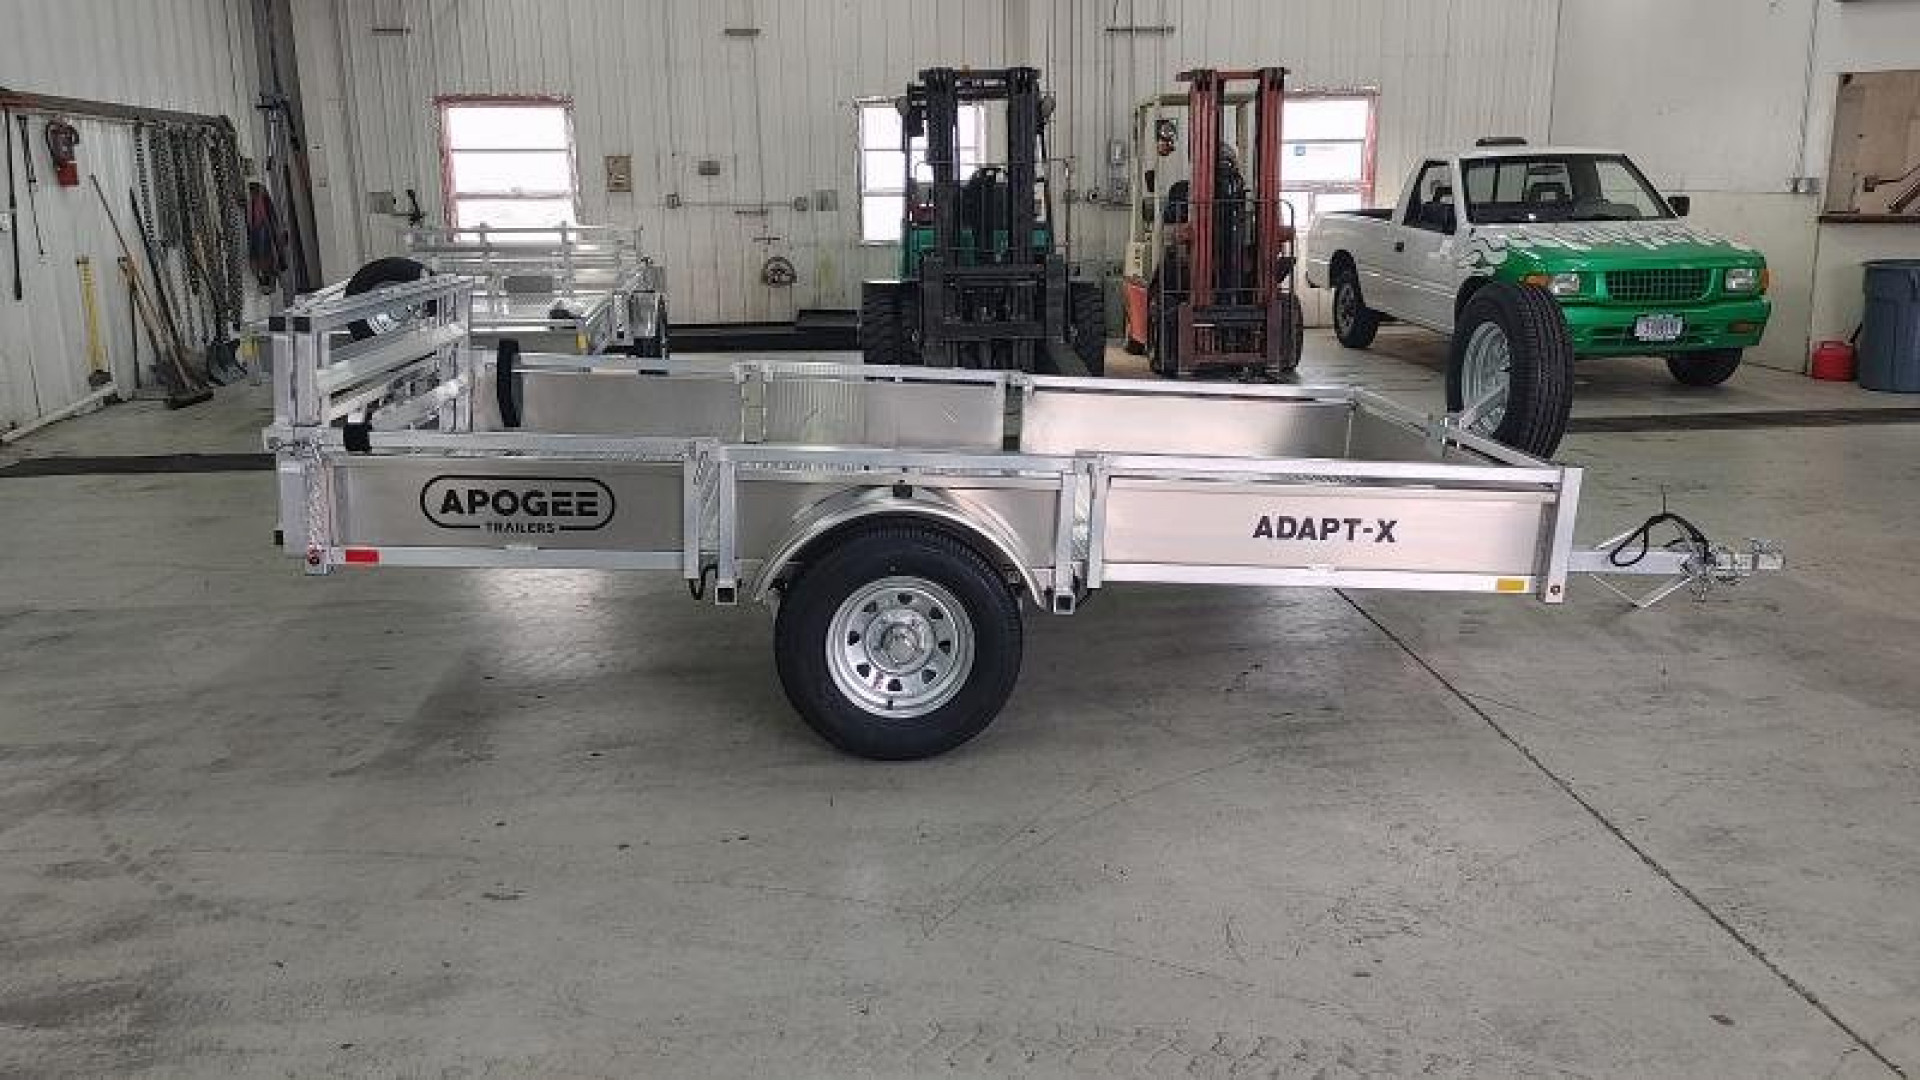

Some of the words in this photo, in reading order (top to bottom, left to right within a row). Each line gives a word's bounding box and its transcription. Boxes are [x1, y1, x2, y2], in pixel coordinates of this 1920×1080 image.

[440, 489, 598, 517] APOGEE
[485, 522, 556, 534] TRAILERS
[1252, 515, 1397, 543] ADAPT-X
